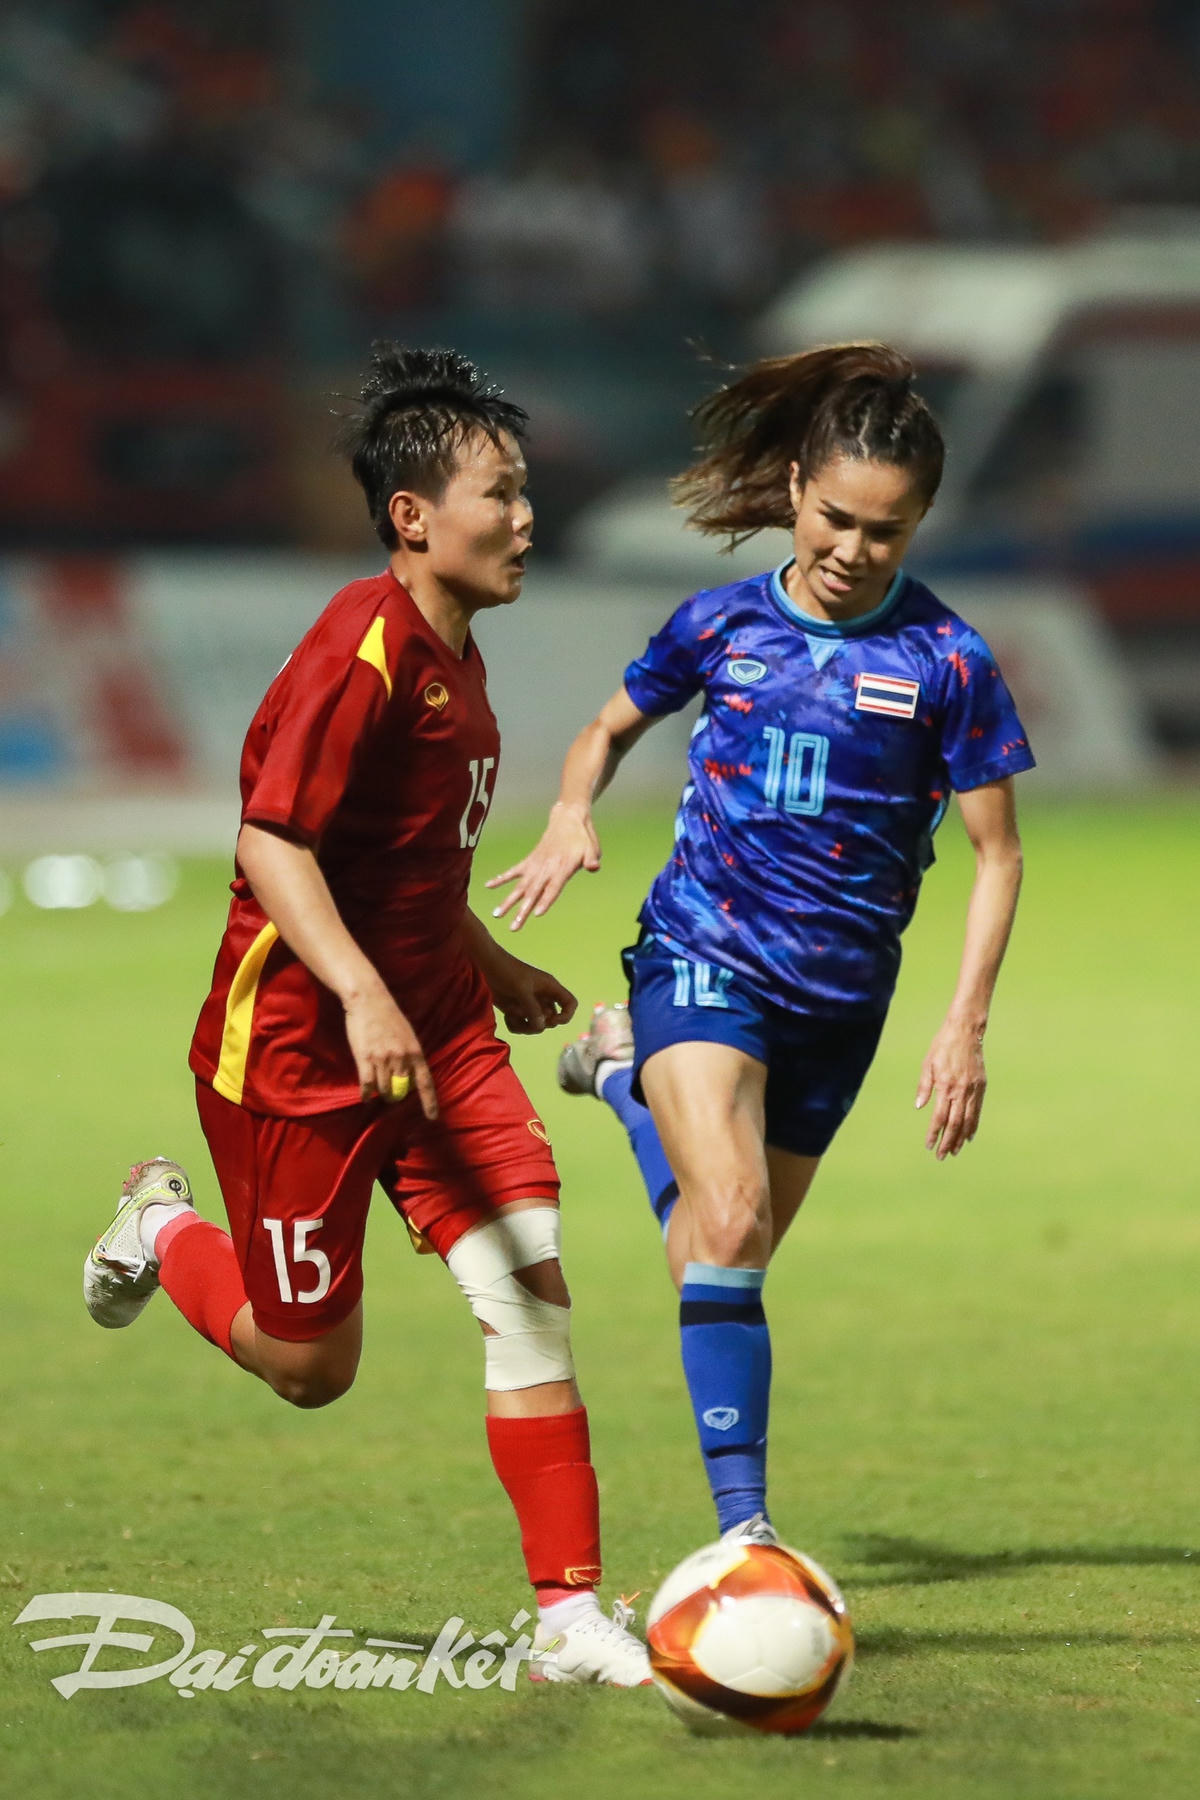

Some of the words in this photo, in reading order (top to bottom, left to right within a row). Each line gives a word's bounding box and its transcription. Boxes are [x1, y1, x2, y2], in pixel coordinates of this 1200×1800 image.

[459, 757, 495, 848] 15
[763, 726, 830, 816] 10
[262, 1217, 331, 1304] 15
